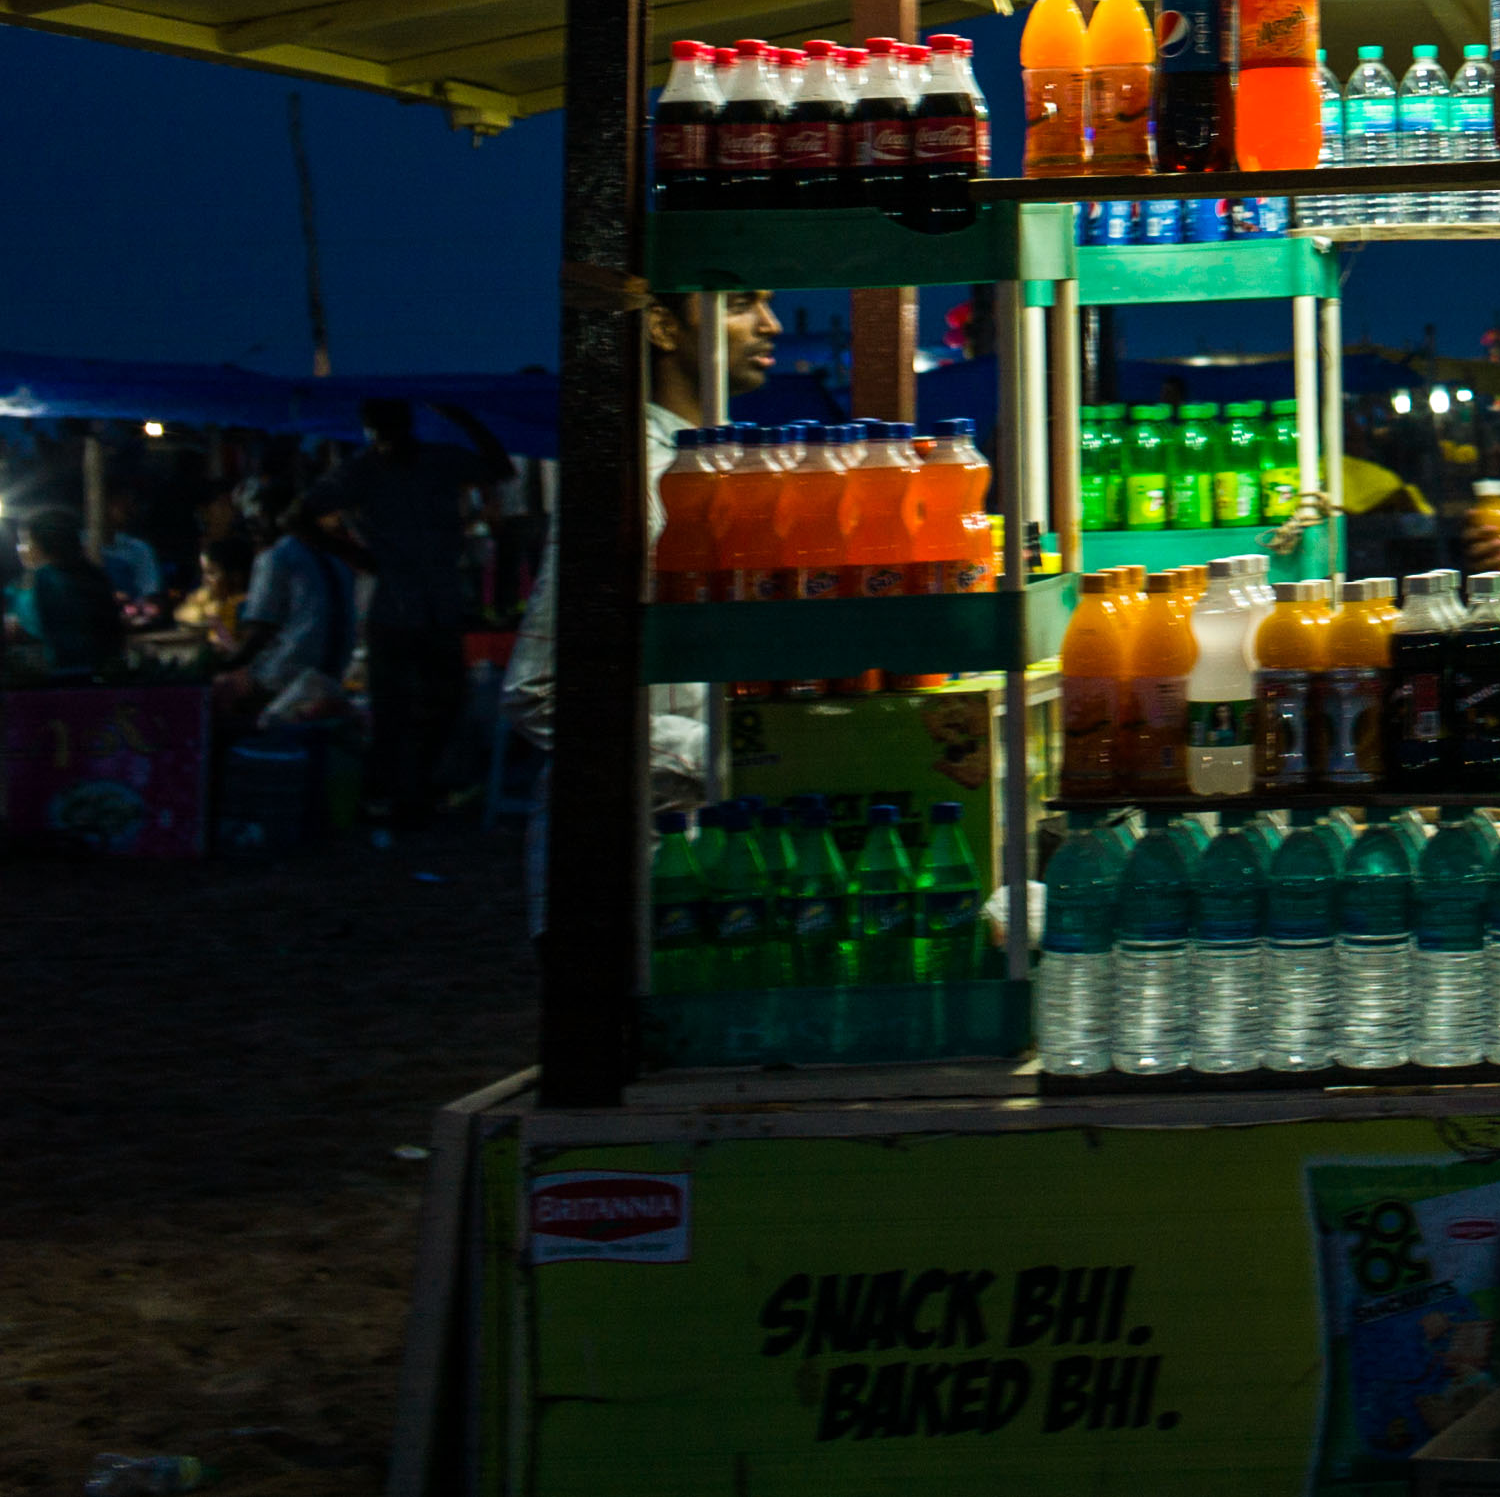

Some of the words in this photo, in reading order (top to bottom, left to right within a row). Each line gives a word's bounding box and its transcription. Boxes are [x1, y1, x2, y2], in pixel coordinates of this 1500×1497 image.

[760, 1268, 996, 1356] SNACK
[1009, 1265, 1153, 1348] BHI.
[817, 1356, 1030, 1442] BAKED
[1042, 1354, 1183, 1432] BHI.
